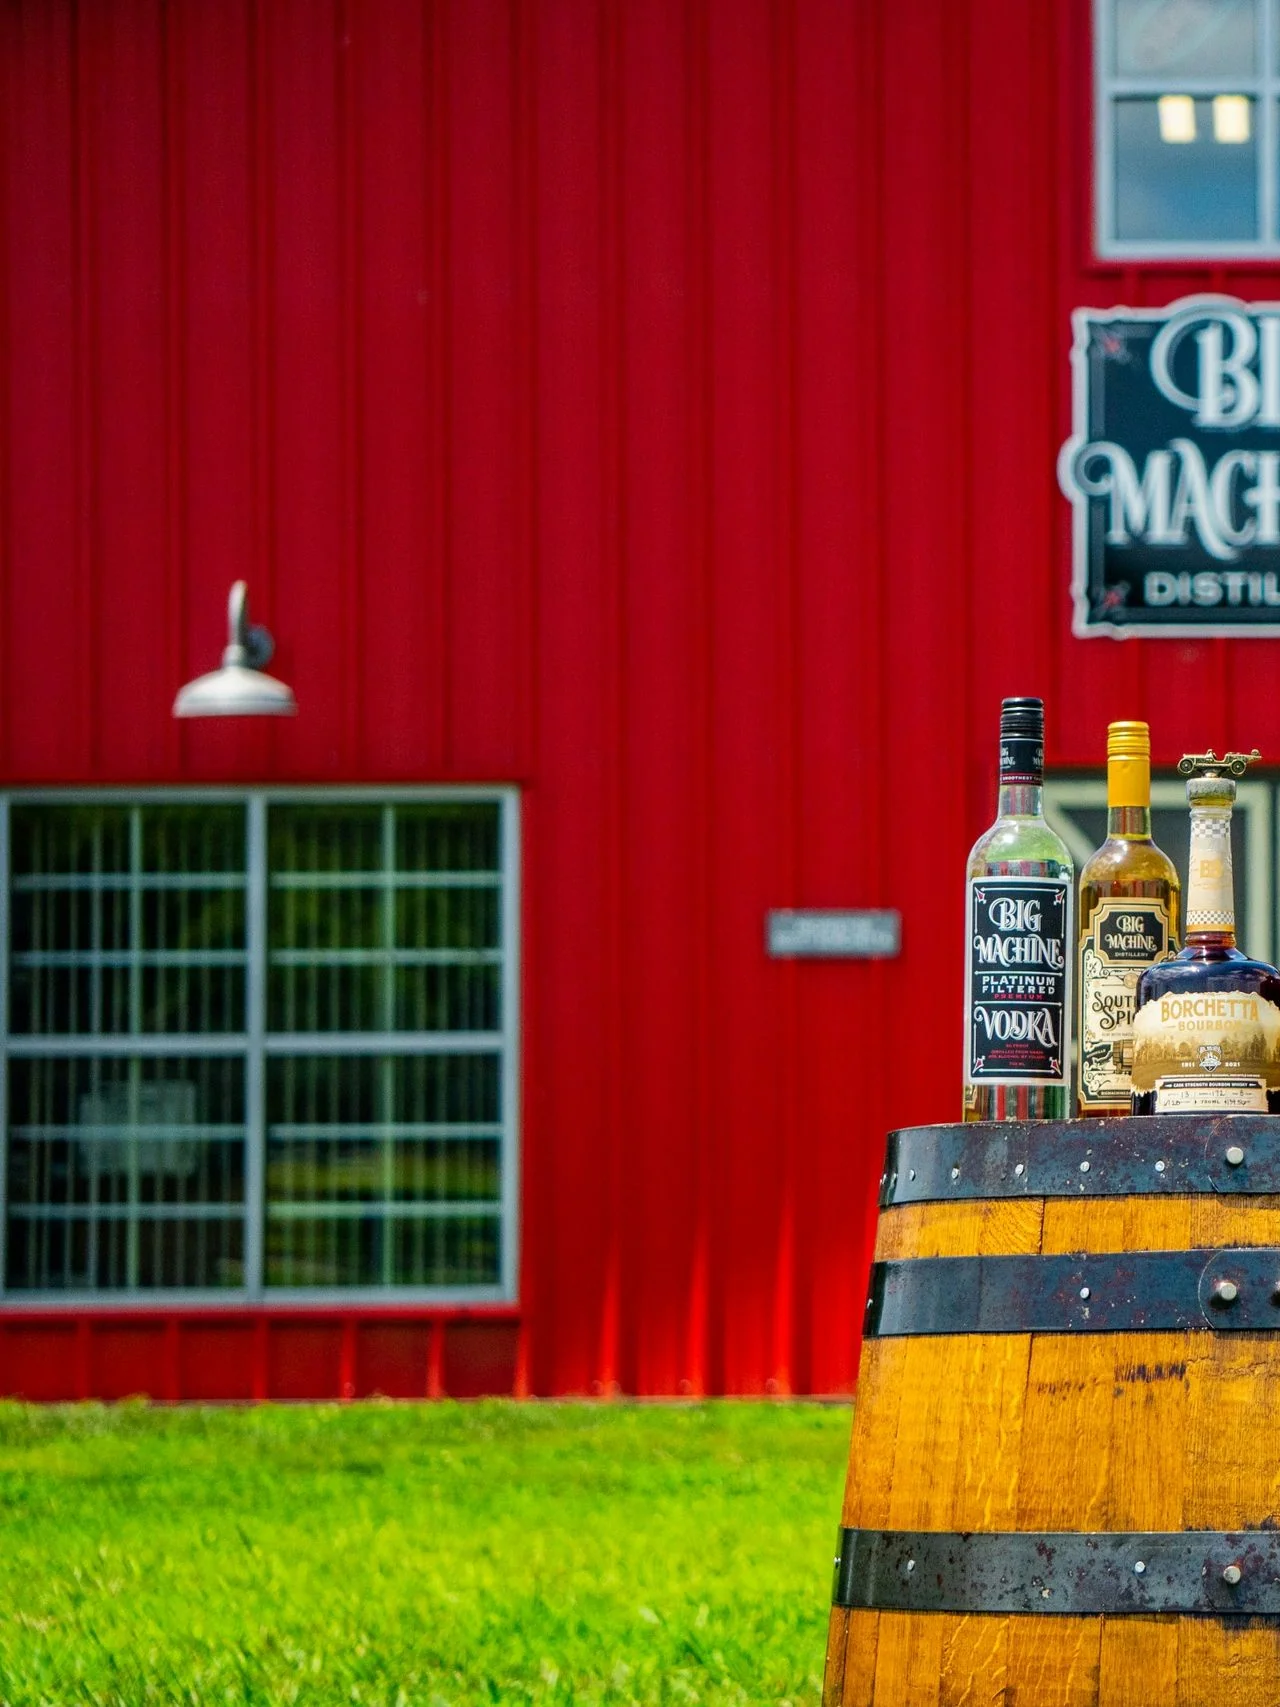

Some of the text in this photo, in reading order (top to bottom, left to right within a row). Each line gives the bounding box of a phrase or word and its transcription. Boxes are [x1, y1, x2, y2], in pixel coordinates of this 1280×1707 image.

[988, 897, 1043, 932] BIG
[1116, 915, 1144, 933] BIG
[973, 933, 1064, 970] MACHINE
[1105, 934, 1157, 952] MACHINE
[982, 975, 1055, 986] PLATINUM
[982, 985, 1055, 995] FILTERED
[1100, 1006, 1135, 1030] SPI
[1161, 999, 1259, 1022] BORCHETTA
[973, 1006, 1058, 1048] VODKA
[1178, 1020, 1243, 1032] BOURBON
